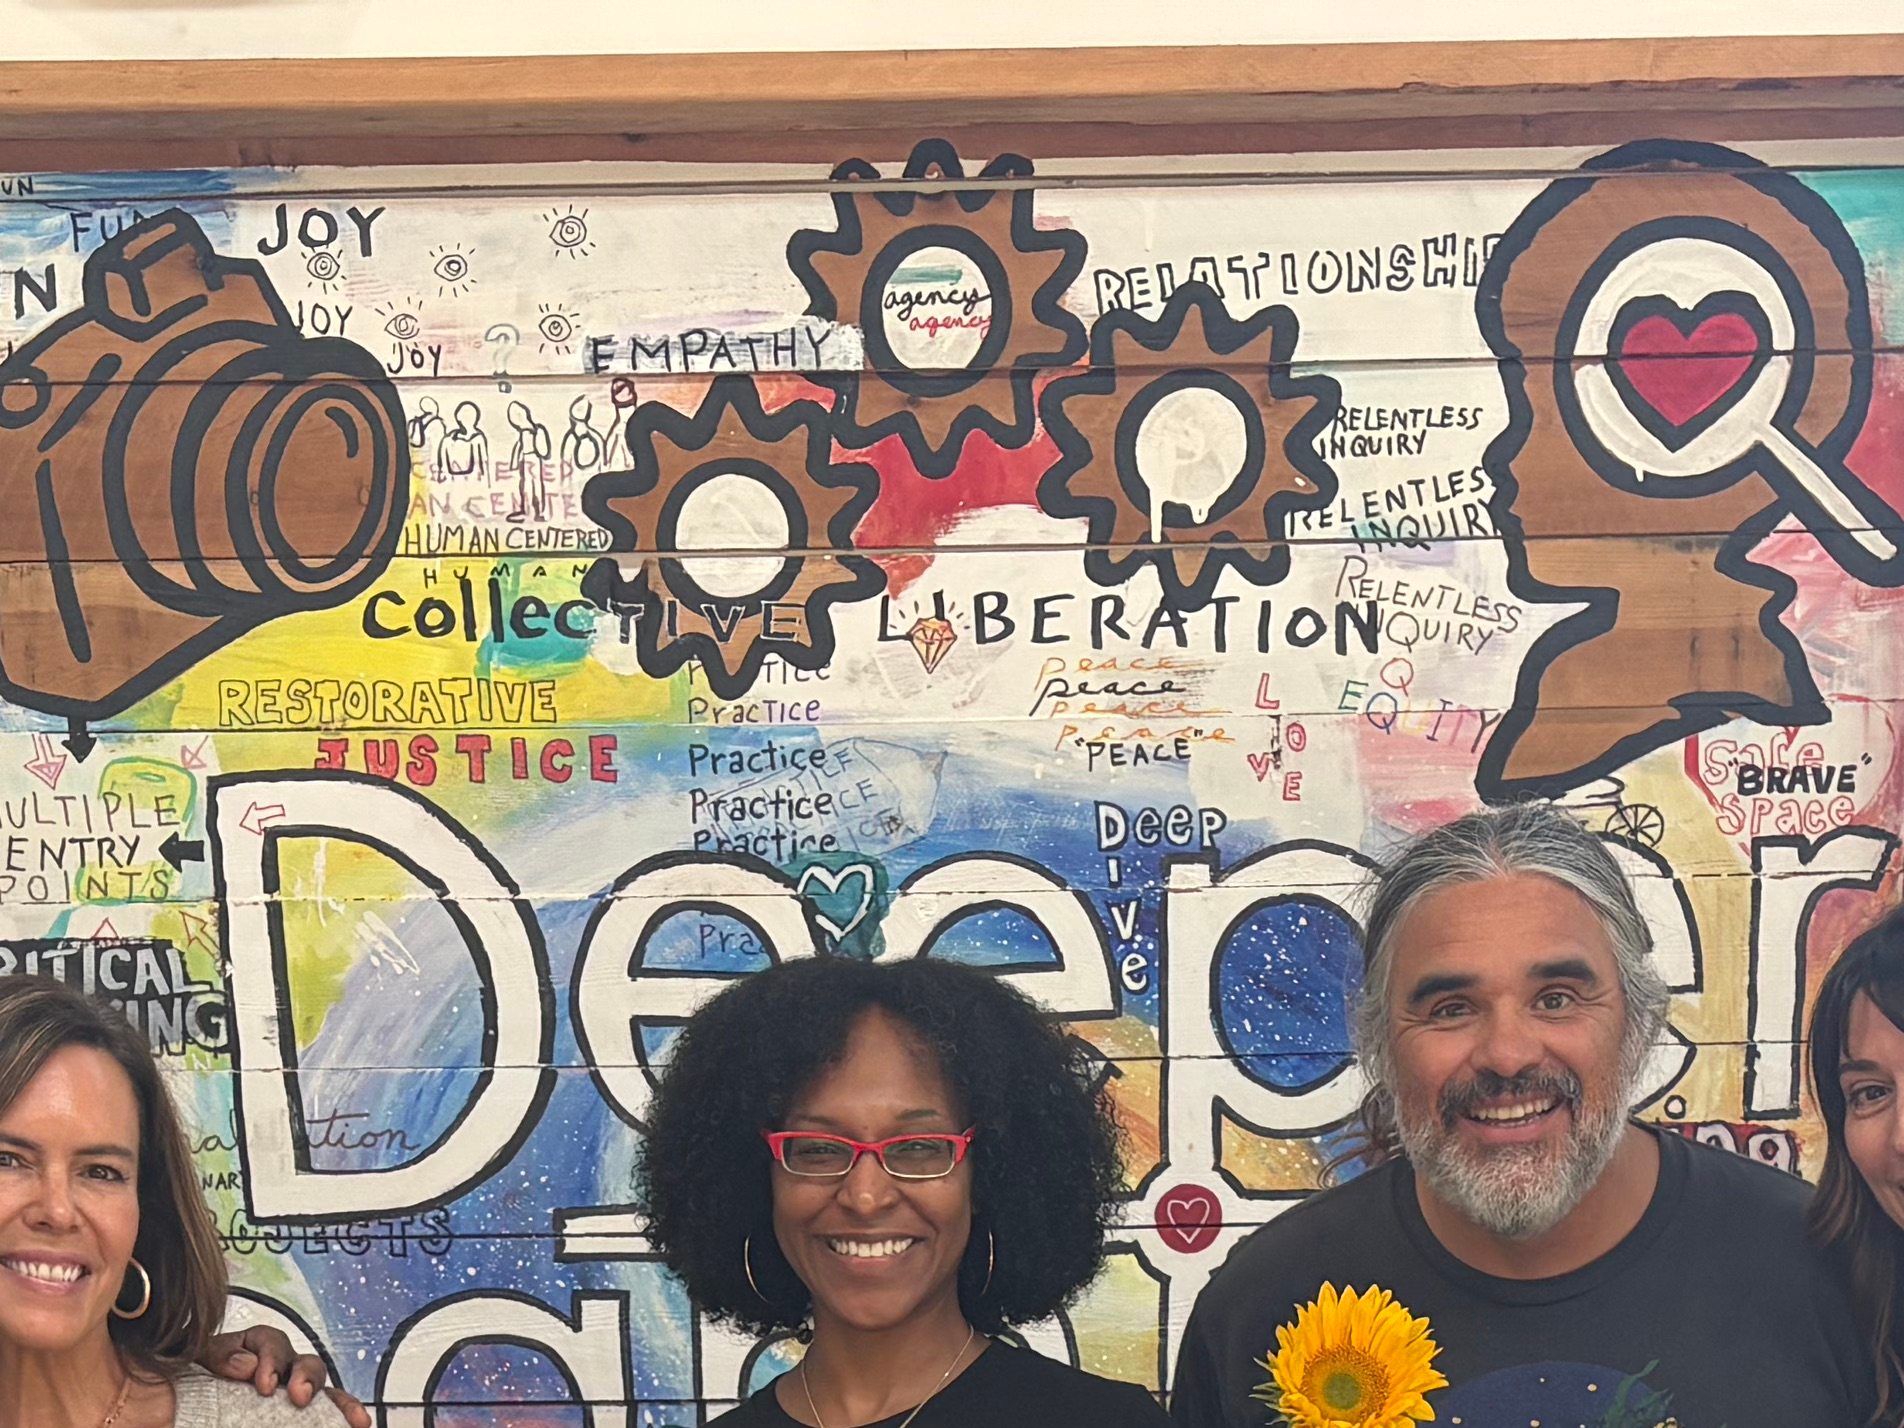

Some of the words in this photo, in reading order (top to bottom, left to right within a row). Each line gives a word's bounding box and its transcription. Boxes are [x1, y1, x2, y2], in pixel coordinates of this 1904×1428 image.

[257, 203, 386, 257] JOY
[297, 300, 353, 336] JOY
[884, 288, 992, 321] agency
[387, 342, 441, 377] JOY
[591, 326, 832, 374] EMPATHY
[1332, 405, 1484, 431] RELENTLESS
[1319, 430, 1427, 459] INQUIRY
[1287, 466, 1486, 537] RELENTLES
[404, 523, 500, 555] HUMAN
[505, 527, 609, 550] CENTERED
[1335, 555, 1522, 633] RELENTLESS
[877, 590, 1379, 656] LIBERATION
[219, 676, 557, 726] RESTORATIVE
[1029, 677, 1186, 717] peace
[315, 733, 620, 786] JUSTICE
[688, 740, 827, 777] Practice
[690, 788, 833, 824] Practice
[7, 836, 141, 872] ENTRY
